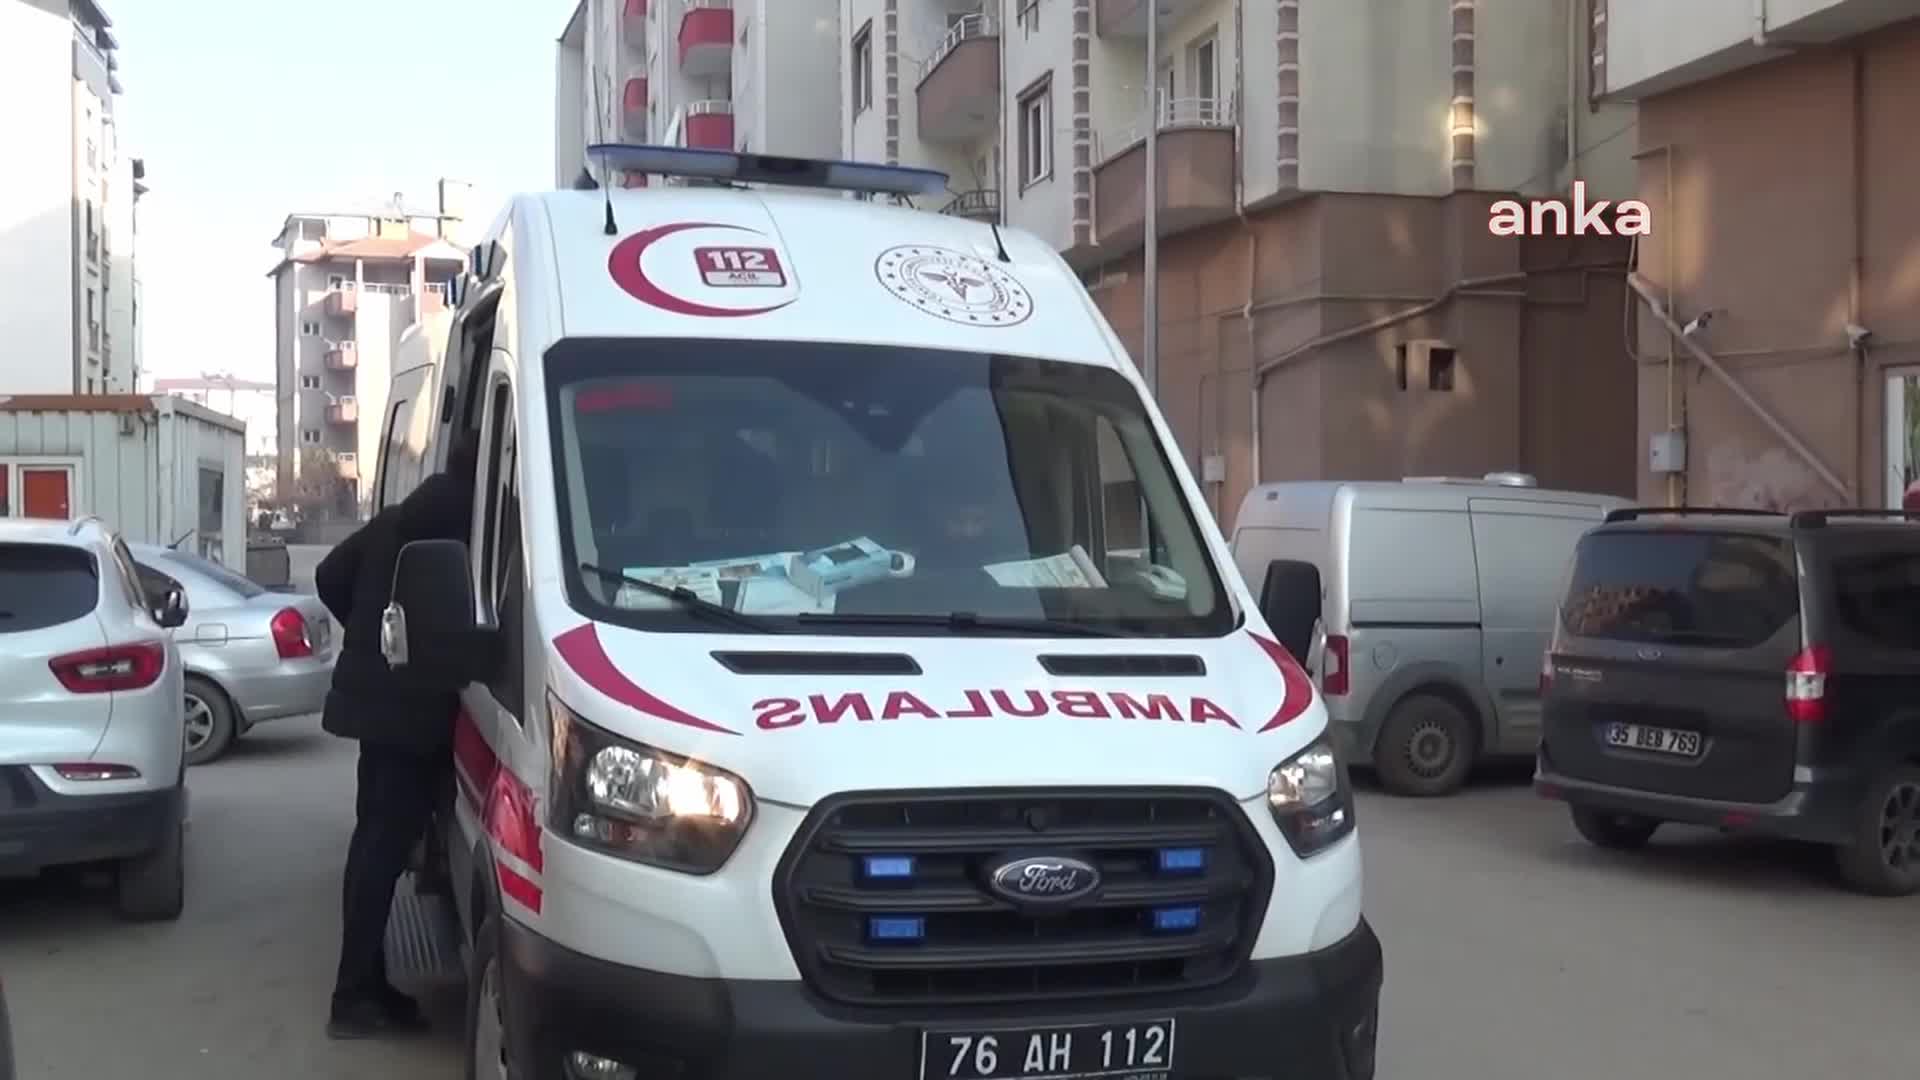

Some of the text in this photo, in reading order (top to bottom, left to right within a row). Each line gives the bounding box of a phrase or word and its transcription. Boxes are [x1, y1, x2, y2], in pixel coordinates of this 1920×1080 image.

[707, 251, 769, 270] 112
[1669, 731, 1698, 753] 769
[1020, 864, 1077, 892] Ford
[950, 1026, 1165, 1075] 76 AH 112
